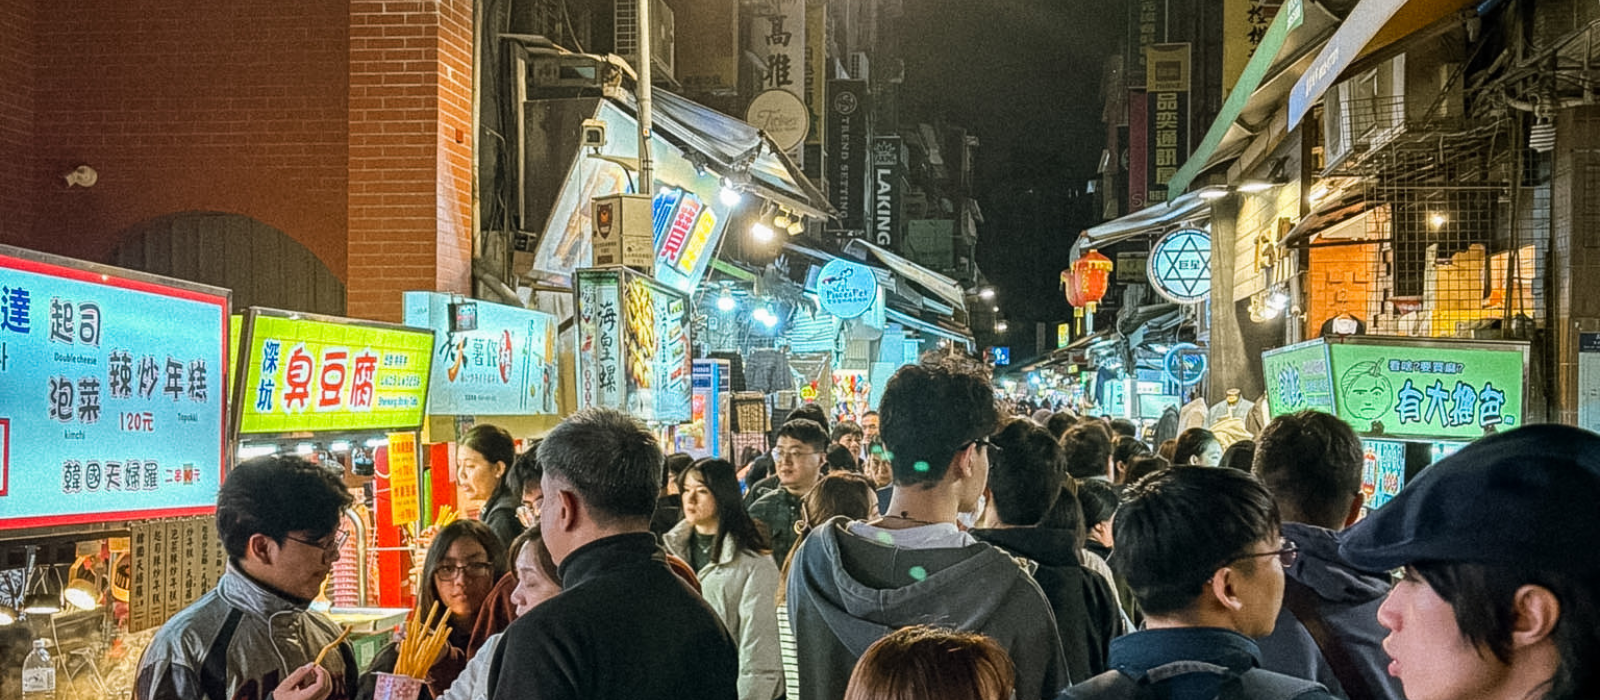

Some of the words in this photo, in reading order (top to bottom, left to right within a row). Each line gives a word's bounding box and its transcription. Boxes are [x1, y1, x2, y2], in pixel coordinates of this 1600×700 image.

[765, 15, 793, 87] 高雅
[841, 117, 850, 160] TREND
[877, 169, 891, 245] LAKING
[1178, 260, 1200, 270] 巨星
[1, 286, 30, 334] 達
[51, 298, 100, 348] 起司
[50, 376, 100, 423] 泡菜
[109, 350, 207, 402] 辣炒年糕
[257, 341, 279, 411] 深坑
[284, 348, 377, 408] 臭豆腐
[119, 412, 154, 431] 120元
[62, 461, 159, 494] 韓國天婦羅
